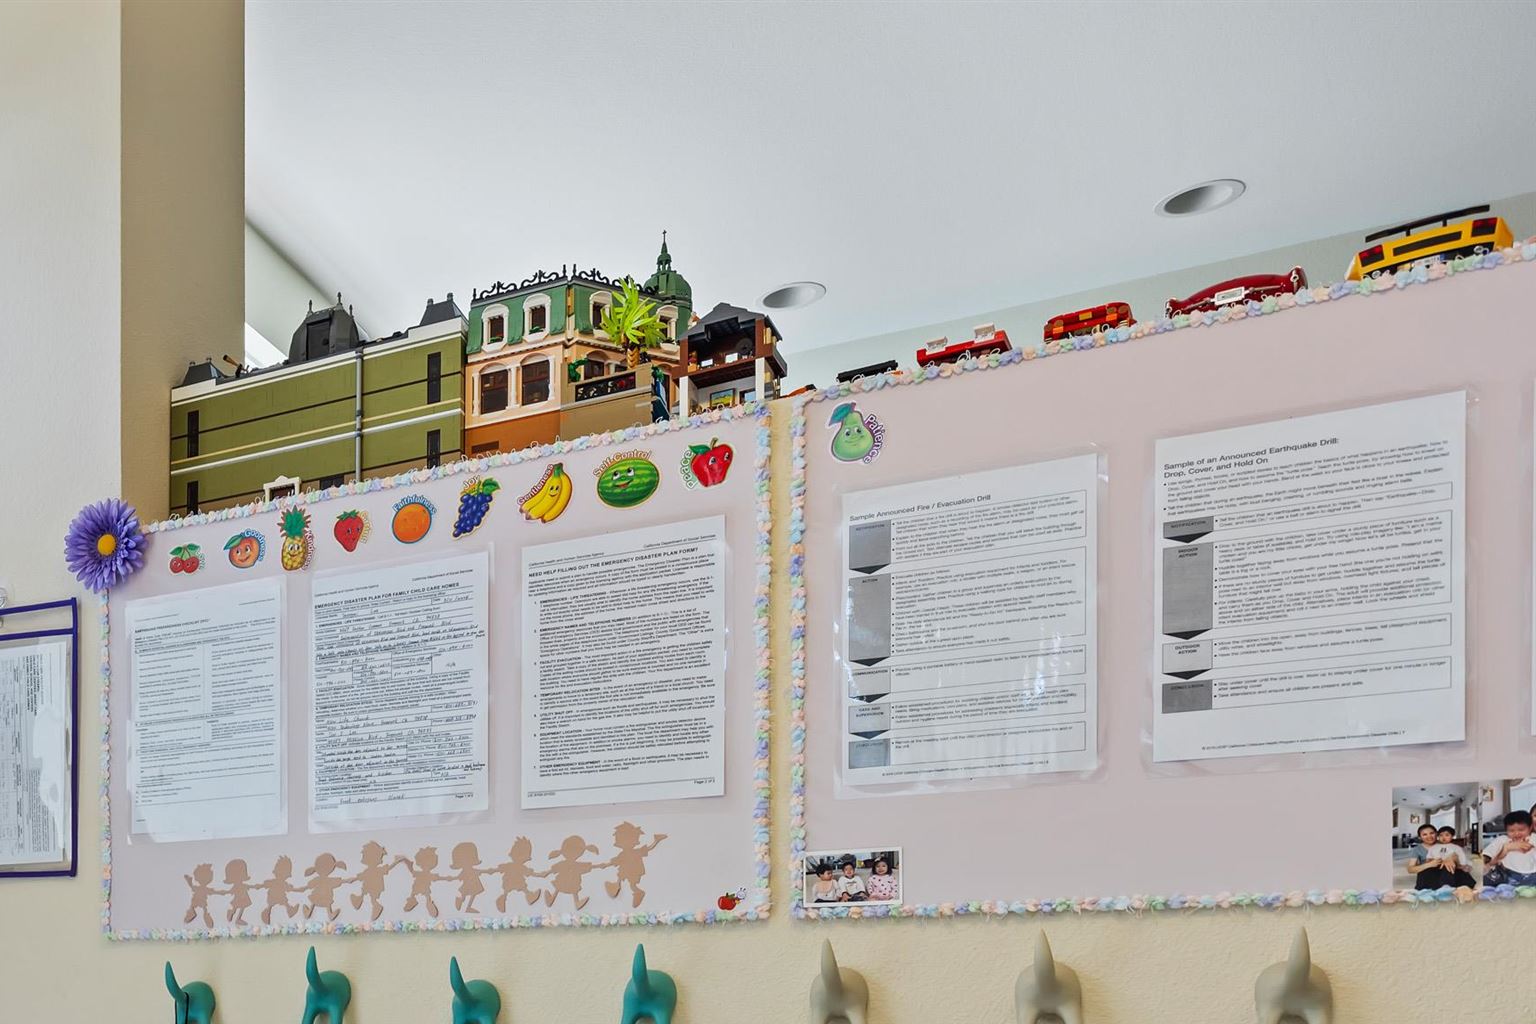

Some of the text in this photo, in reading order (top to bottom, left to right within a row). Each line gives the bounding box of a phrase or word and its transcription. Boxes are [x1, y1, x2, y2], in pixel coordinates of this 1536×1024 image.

[863, 413, 886, 464] Patience
[592, 448, 653, 477] Self-Control
[1164, 460, 1193, 470] Sample
[1219, 448, 1266, 462] Announced
[1269, 440, 1317, 454] Earthquake
[1319, 437, 1339, 446] Drill:
[1164, 469, 1185, 478] Drop,
[1188, 465, 1213, 474] Cover,
[1216, 462, 1231, 470] and
[1234, 459, 1253, 468] Hold
[517, 463, 554, 505] Gentleness
[392, 494, 437, 514] Faithfulness
[849, 512, 874, 521] Sample
[876, 506, 914, 517] Announced
[936, 497, 975, 508] Evacuation
[557, 565, 576, 573] FILLING
[601, 557, 633, 566] EMERGENCY
[635, 552, 661, 561] DISASTER
[679, 546, 698, 554] FORM?
